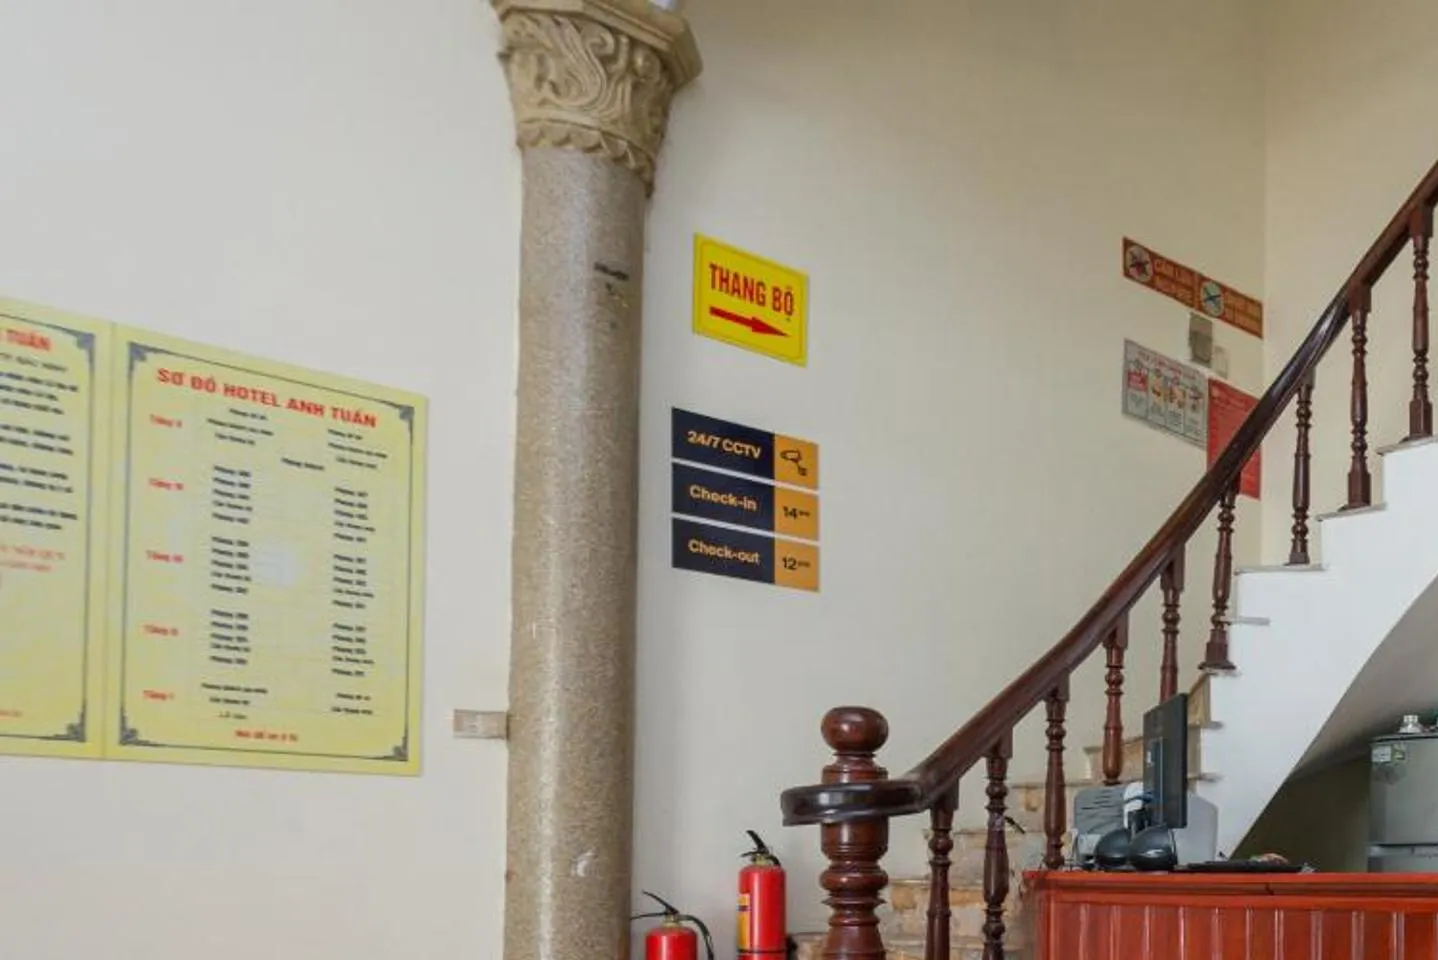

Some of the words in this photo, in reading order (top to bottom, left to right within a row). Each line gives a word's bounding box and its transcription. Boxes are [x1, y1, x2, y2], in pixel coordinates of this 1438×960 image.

[709, 262, 766, 307] THANG
[772, 285, 793, 322] BỘ
[157, 367, 184, 386] SƠ
[223, 383, 280, 408] HOTEL
[285, 397, 325, 419] ANH
[687, 430, 720, 449] 24/7
[722, 438, 761, 459] CCTV
[689, 484, 757, 512] Check-in
[688, 538, 760, 564] Check-out
